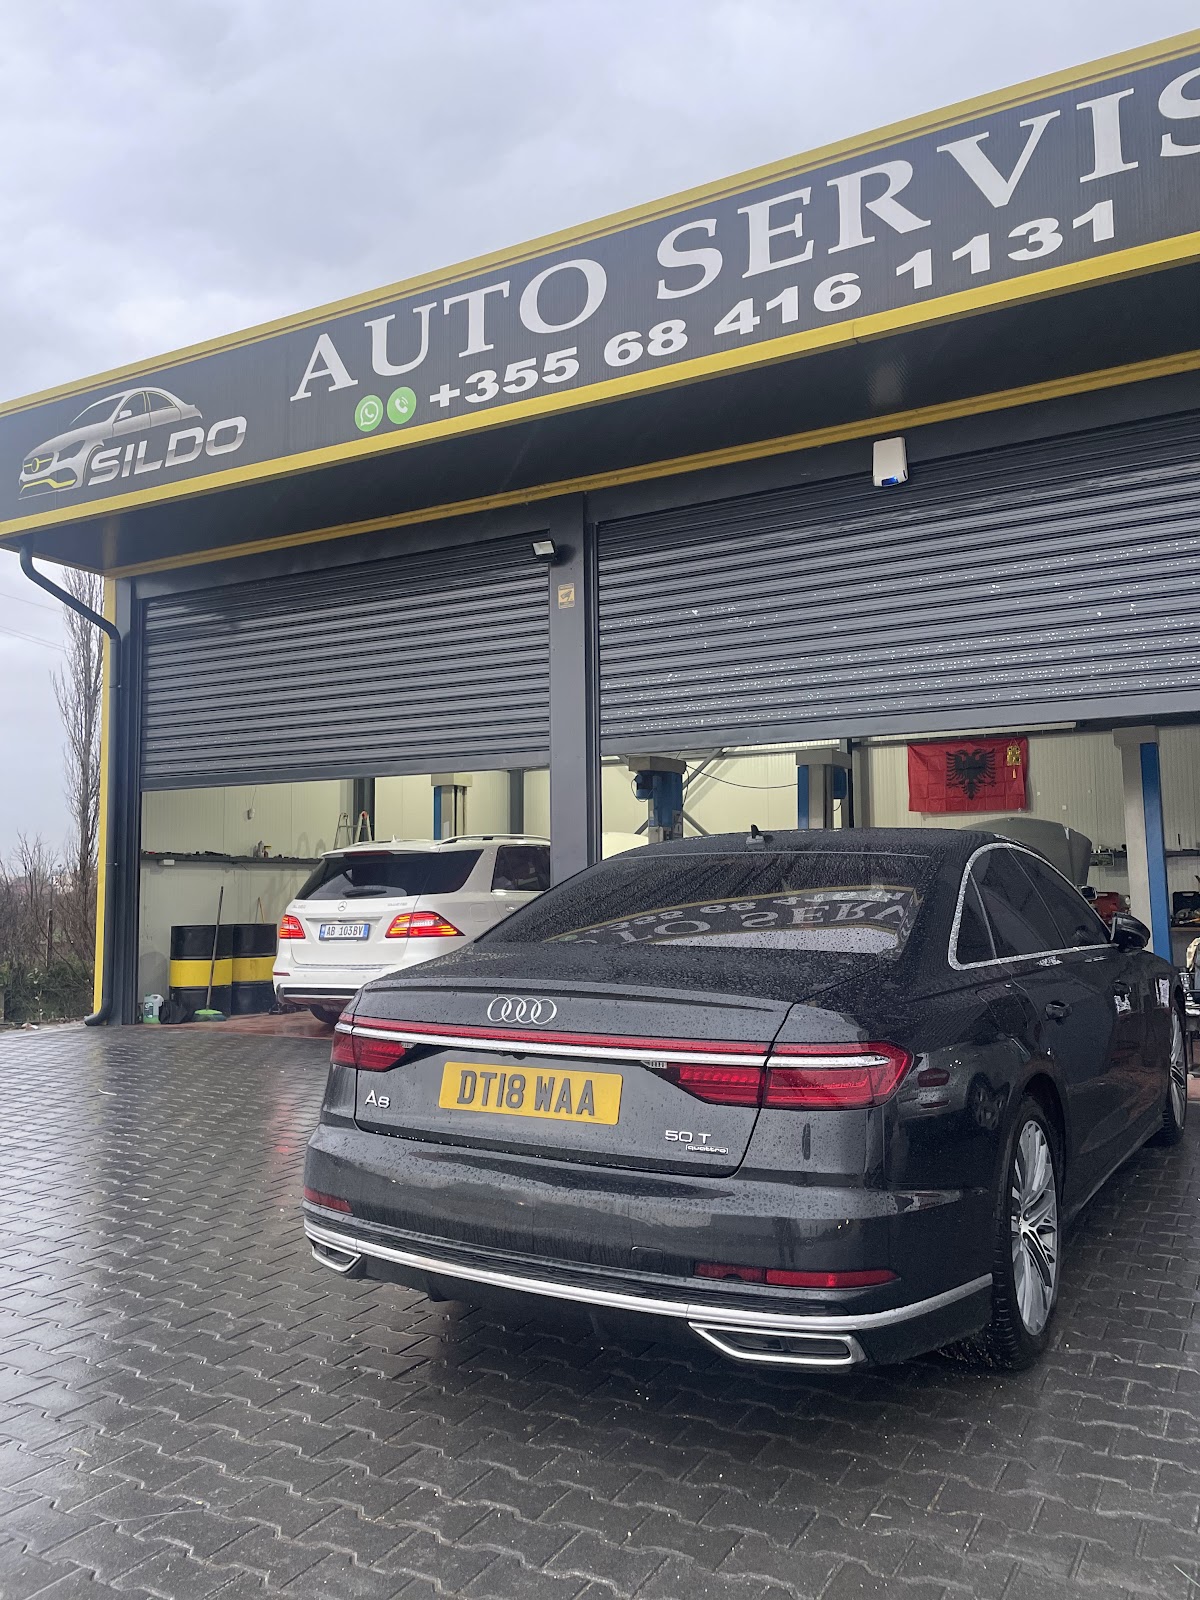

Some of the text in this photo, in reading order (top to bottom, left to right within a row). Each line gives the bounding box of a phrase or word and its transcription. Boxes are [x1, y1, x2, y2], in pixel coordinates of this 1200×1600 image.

[290, 67, 1200, 402] AUTO SERVIS
[429, 199, 1116, 408] +355 68 416 1131
[87, 415, 248, 486] SILDO
[364, 1089, 391, 1109] A8
[534, 1076, 595, 1117] WAA
[664, 1129, 712, 1145] 50 T
[686, 1145, 729, 1155] quattro
